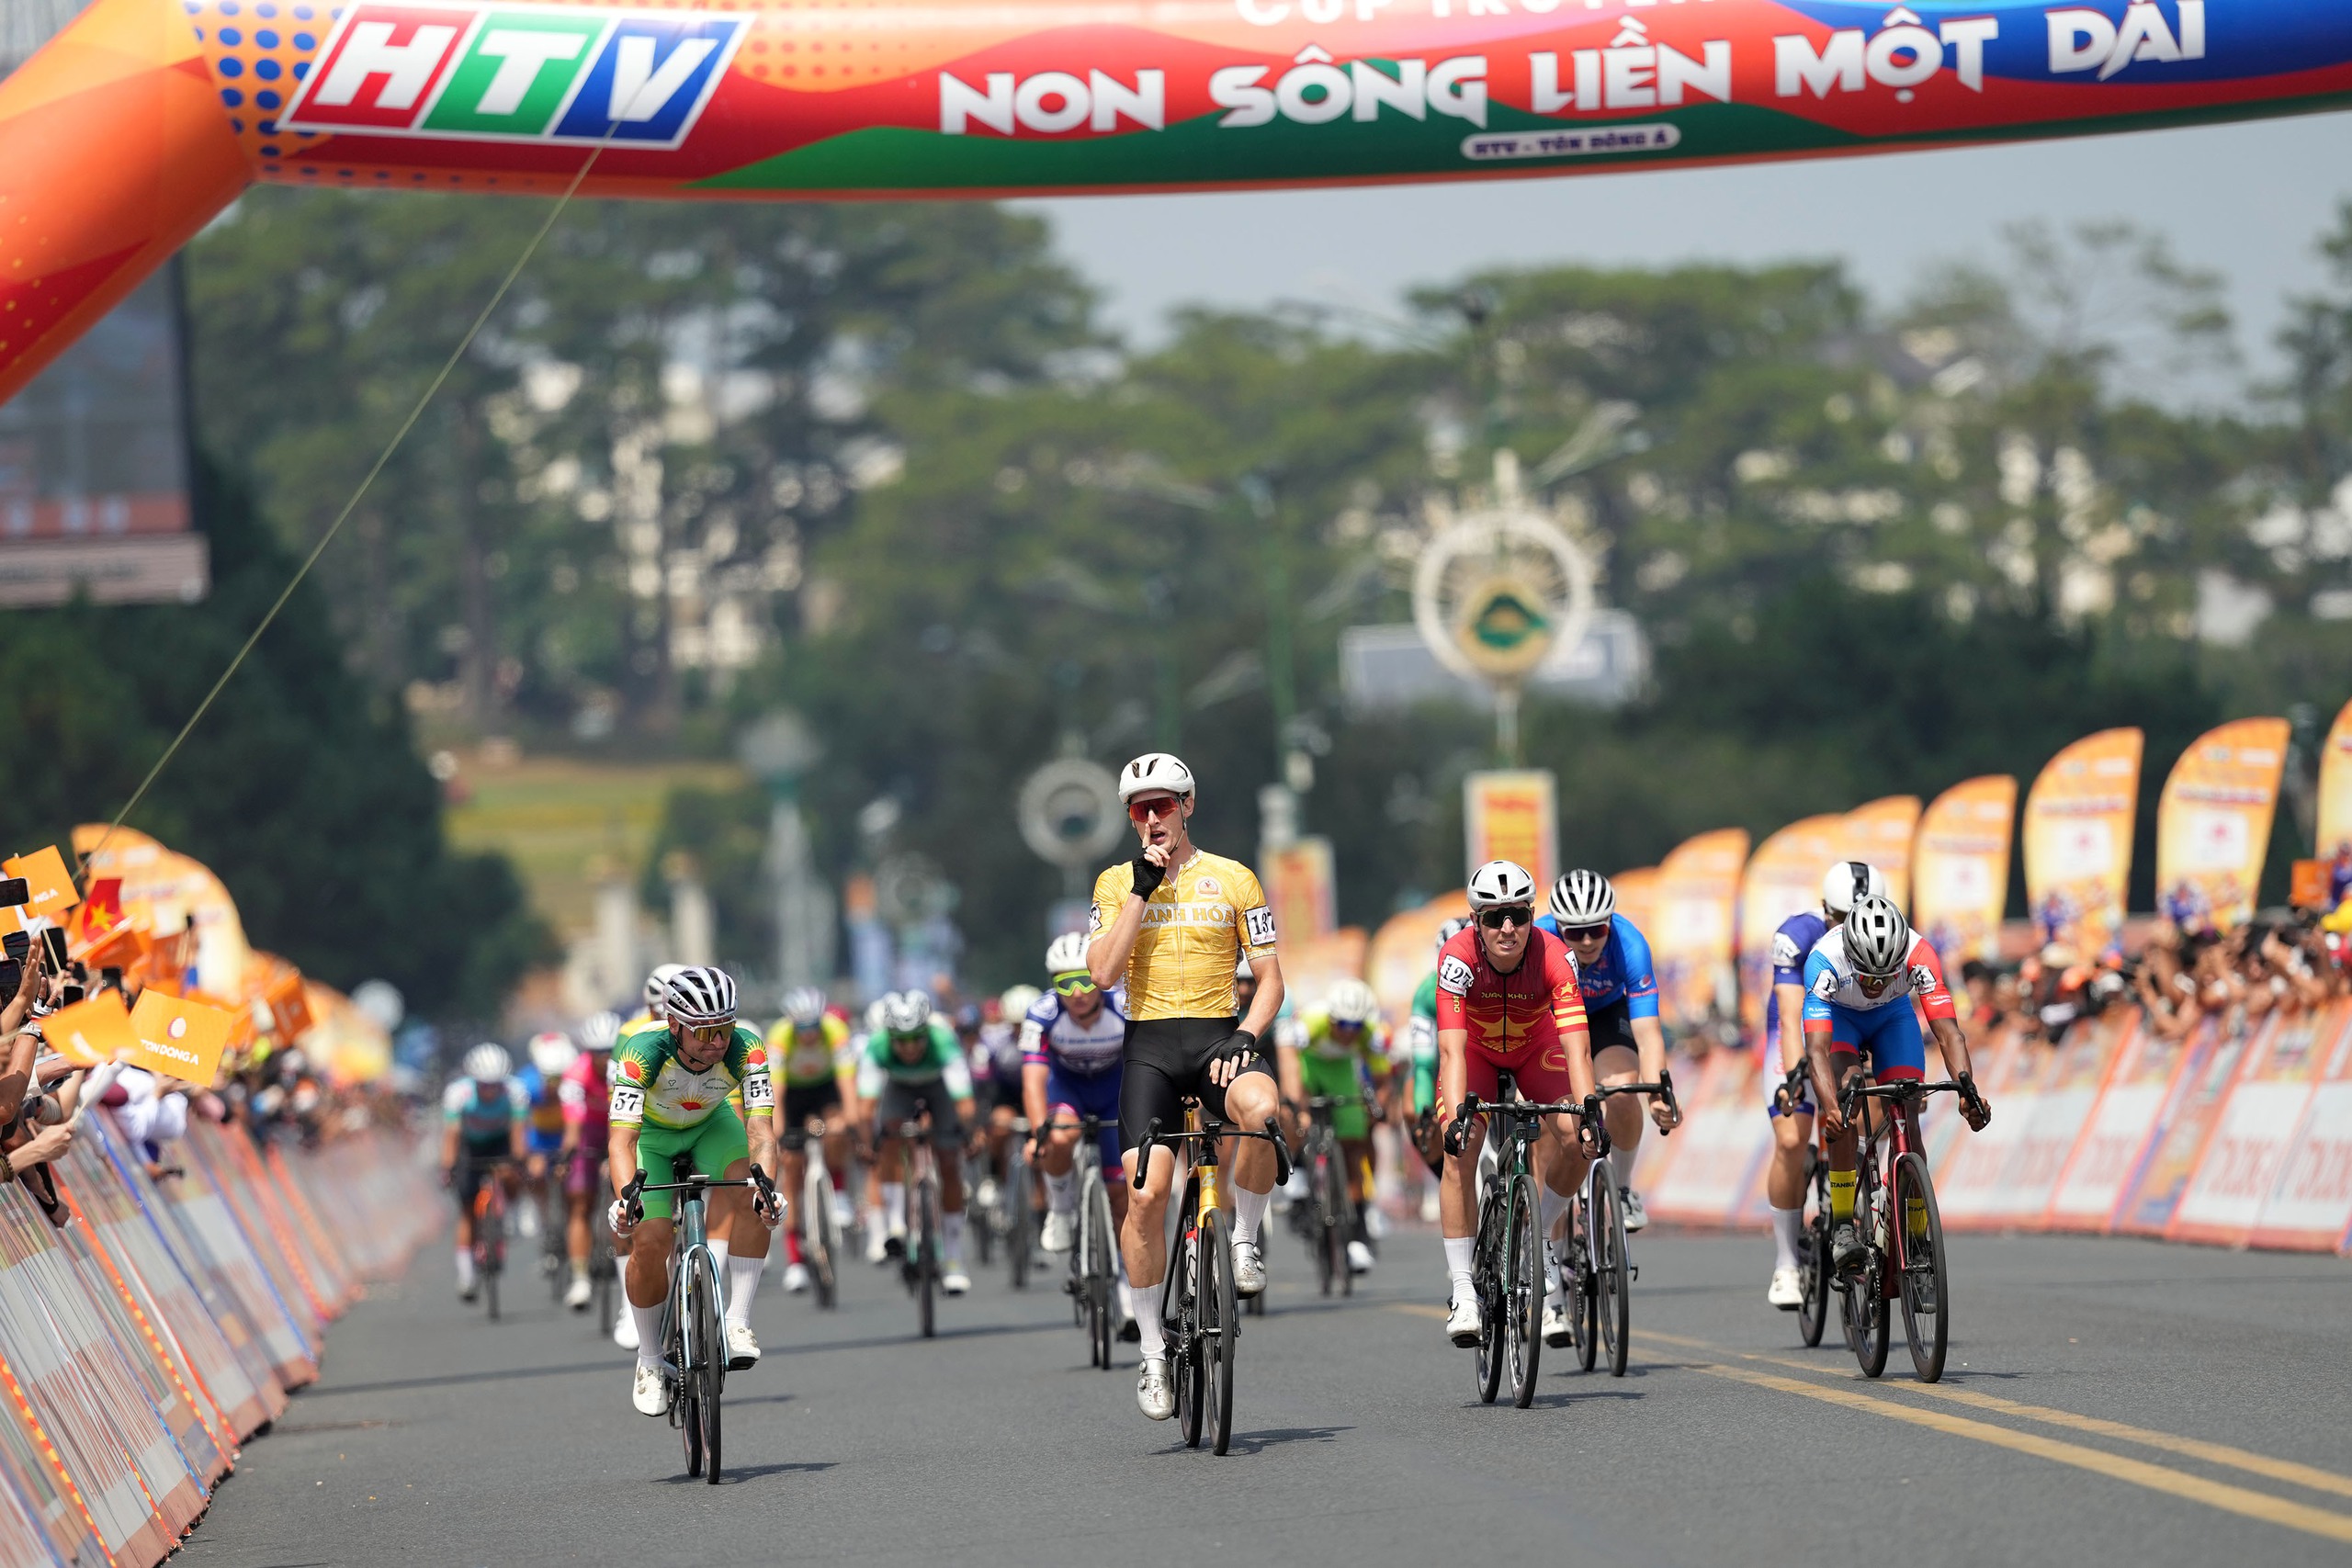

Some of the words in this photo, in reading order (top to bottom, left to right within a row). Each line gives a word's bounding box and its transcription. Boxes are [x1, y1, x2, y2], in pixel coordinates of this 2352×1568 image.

[312, 21, 718, 122] HTV
[940, 69, 1164, 135] NON
[1210, 43, 1487, 128] SÔNG
[1529, 15, 1731, 113] LIỀN
[1772, 6, 1998, 103] MỘT
[1442, 964, 1472, 986] 127
[159, 1044, 191, 1062] DONG
[189, 1055, 199, 1066] A
[615, 1092, 639, 1111] 57
